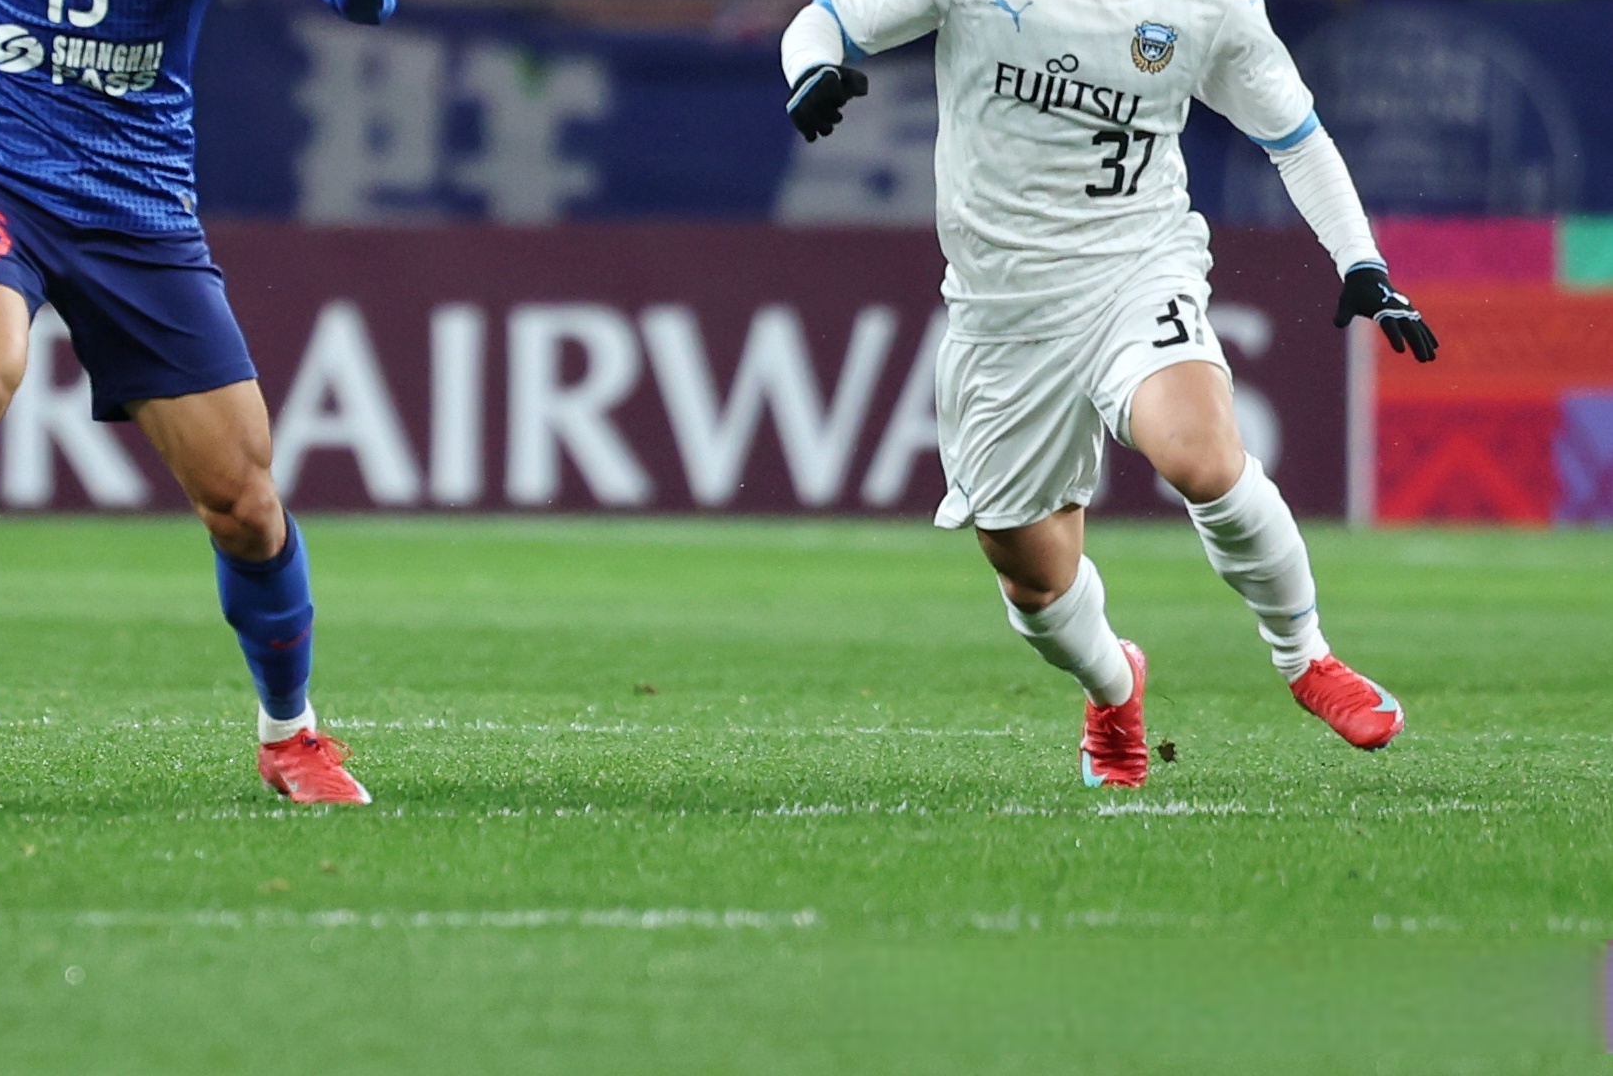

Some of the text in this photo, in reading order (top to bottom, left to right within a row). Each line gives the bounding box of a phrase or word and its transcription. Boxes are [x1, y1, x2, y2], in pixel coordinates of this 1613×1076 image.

[51, 34, 164, 73] SHANGHAI
[994, 54, 1142, 125] FUJITSU
[1085, 130, 1156, 197] 37
